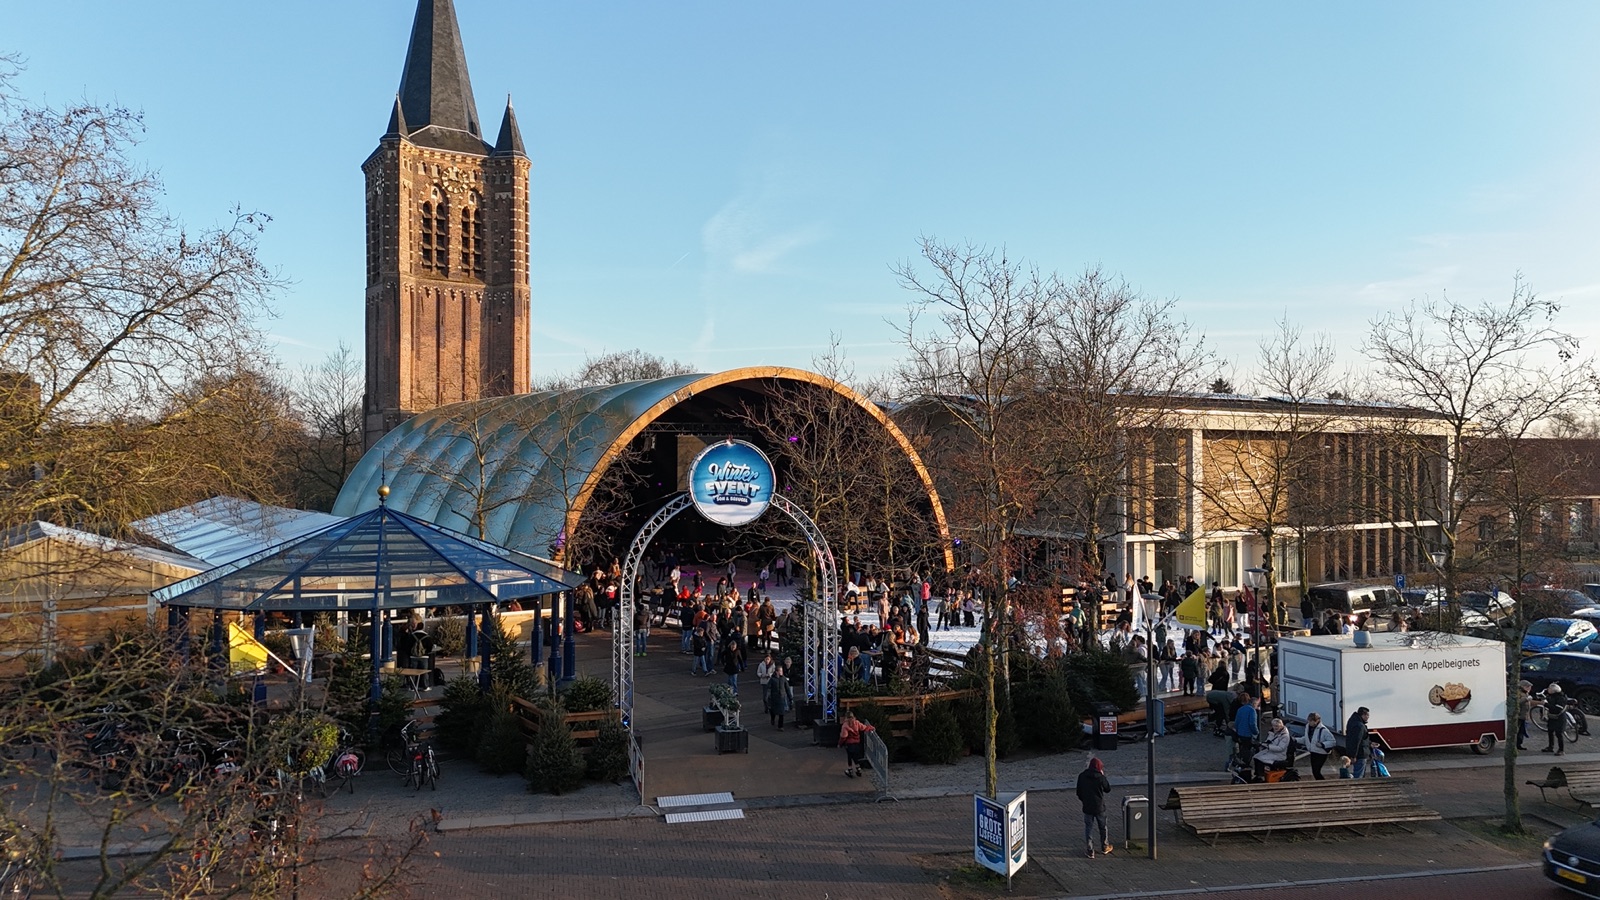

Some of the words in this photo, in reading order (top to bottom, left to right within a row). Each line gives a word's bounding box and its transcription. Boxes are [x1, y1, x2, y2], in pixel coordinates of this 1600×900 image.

[708, 461, 759, 482] Winter
[705, 481, 760, 498] EVENT
[1363, 662, 1405, 672] Oliebollen
[1408, 662, 1418, 670] en
[1421, 658, 1480, 671] Appelbeignets
[979, 813, 1002, 836] GROTE
